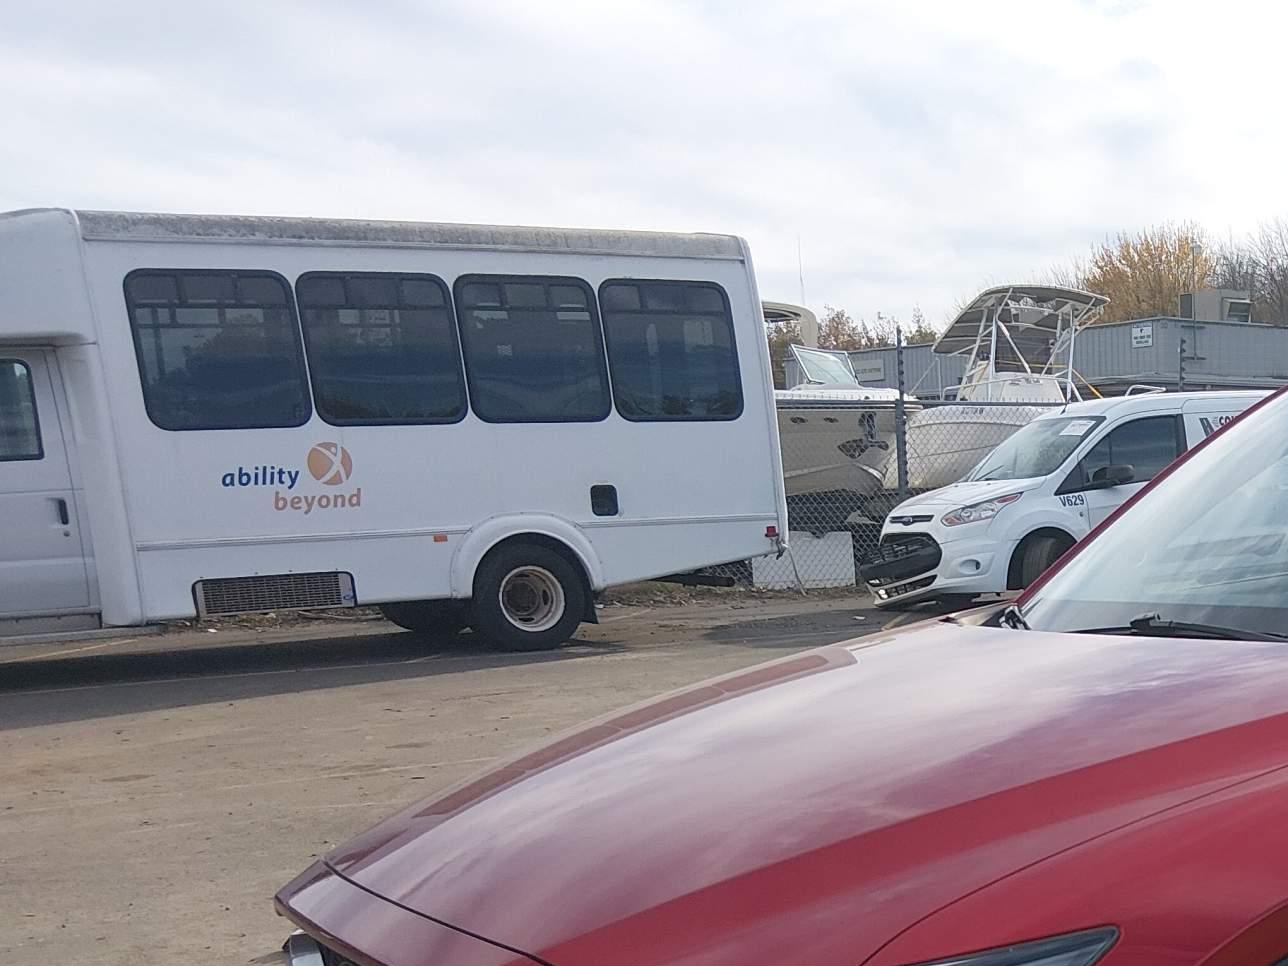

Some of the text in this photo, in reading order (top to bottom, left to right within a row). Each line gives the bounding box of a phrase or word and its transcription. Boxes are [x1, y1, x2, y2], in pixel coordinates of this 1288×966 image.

[221, 465, 300, 490] ability
[273, 487, 362, 515] beyond
[1059, 494, 1085, 507] V629
